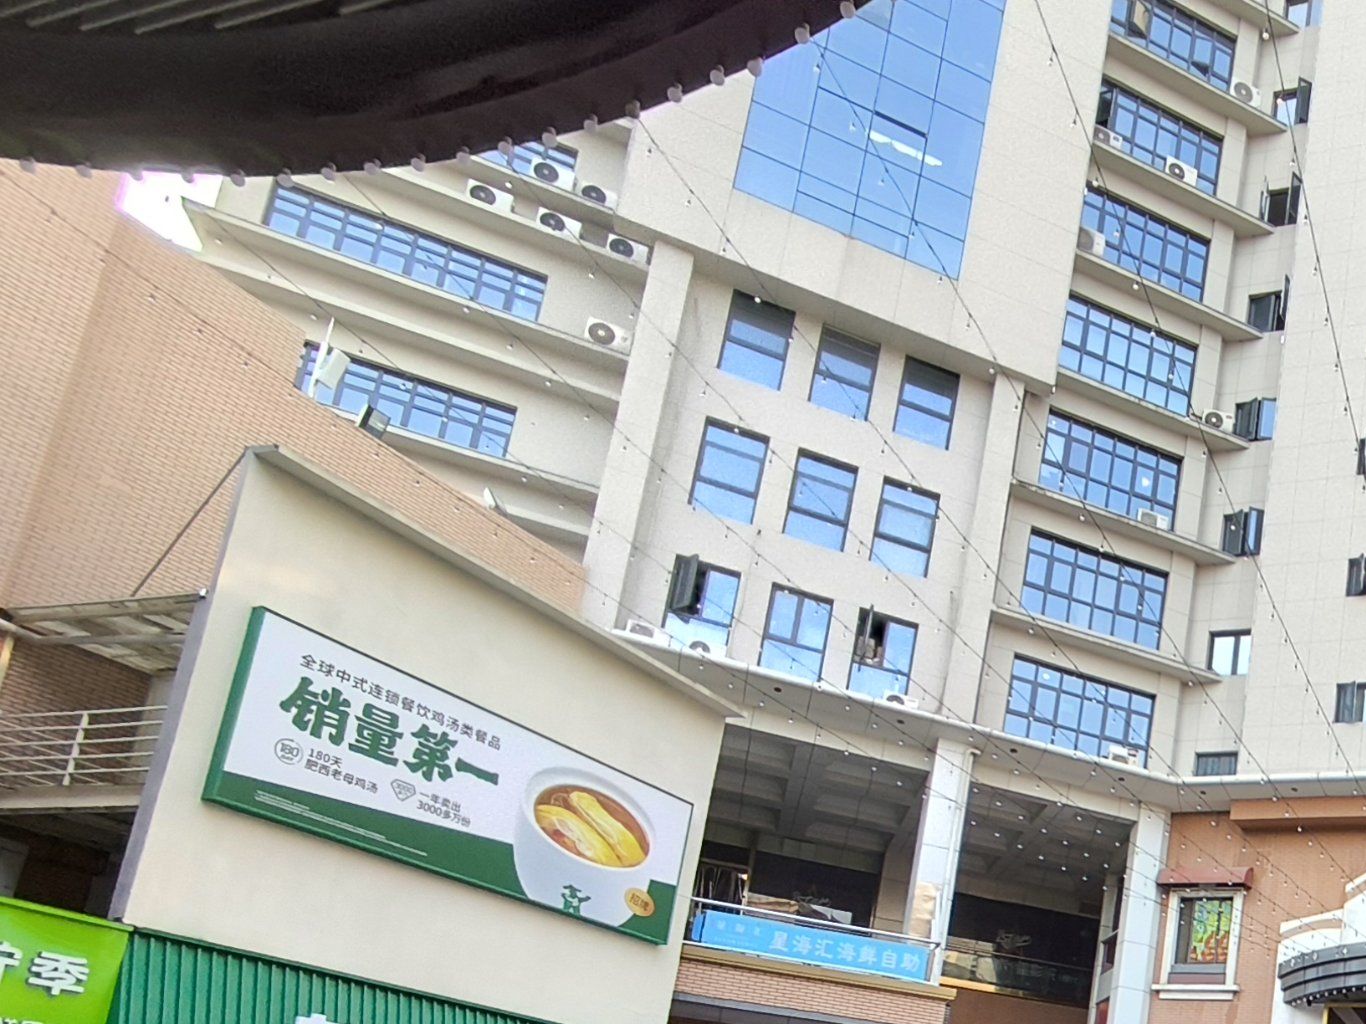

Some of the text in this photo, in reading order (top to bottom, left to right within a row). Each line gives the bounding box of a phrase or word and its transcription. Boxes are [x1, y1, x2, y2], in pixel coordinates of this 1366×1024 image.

[300, 653, 501, 750] 全球中式连锁餐饮鸡汤类餐品
[279, 677, 500, 786] 销量第一
[308, 748, 343, 769] 180天
[304, 759, 378, 794] 肥西老母鸡汤
[416, 800, 471, 828] 3000多万份
[419, 790, 461, 812] 一年卖出
[769, 931, 921, 973] 星海汇海鲜自助
